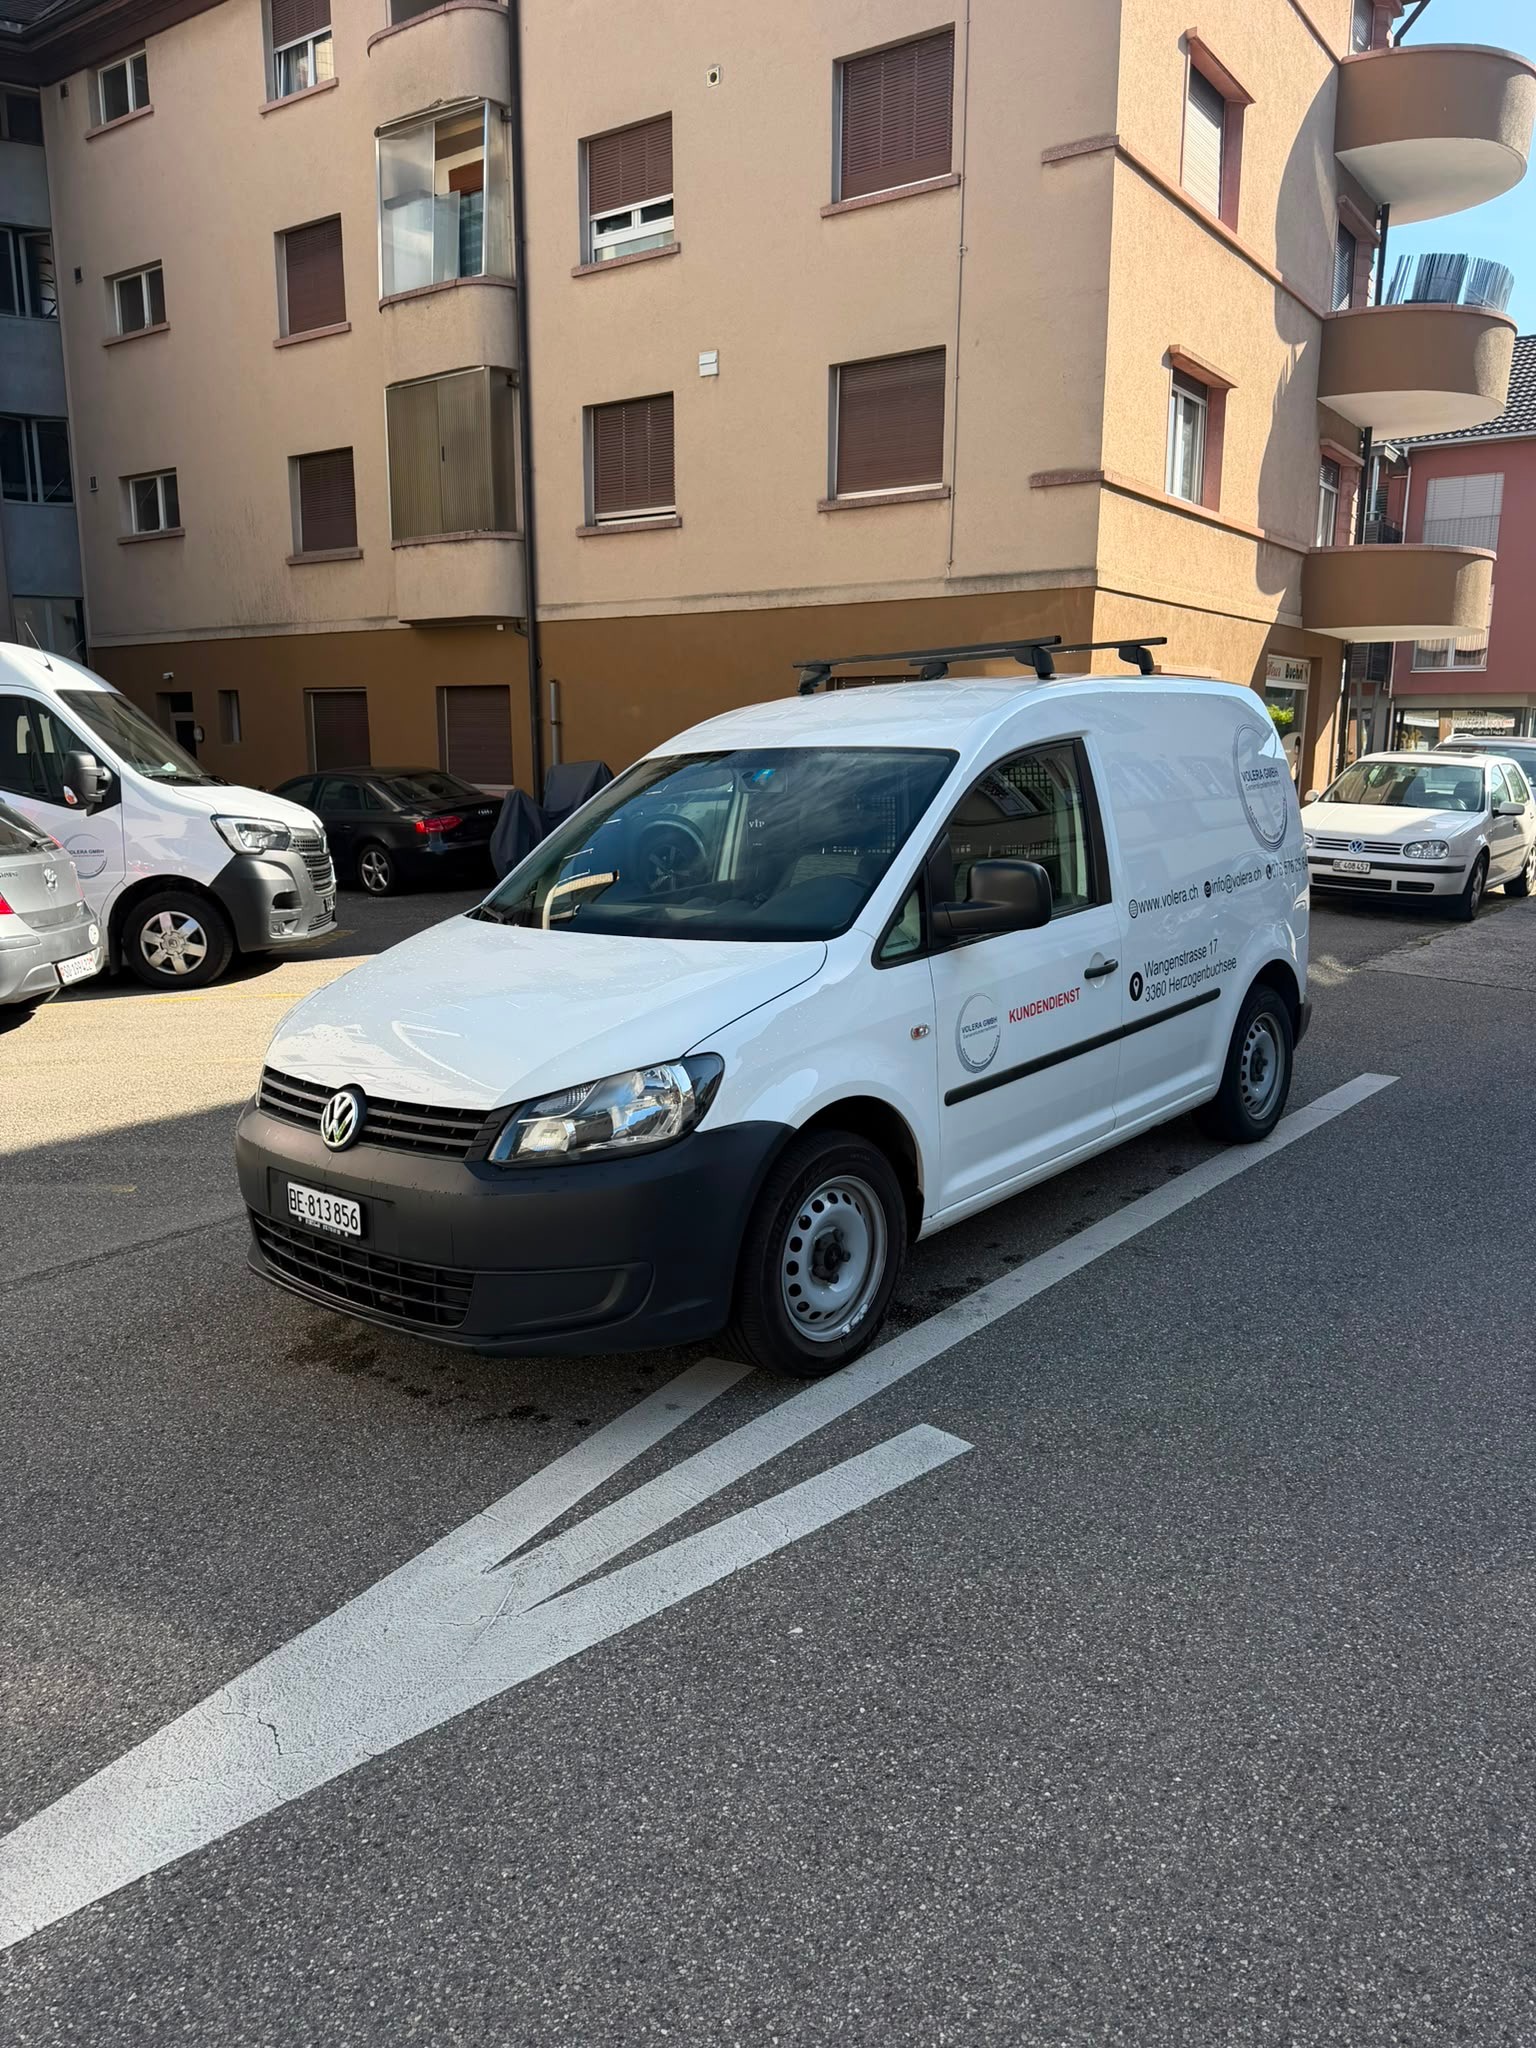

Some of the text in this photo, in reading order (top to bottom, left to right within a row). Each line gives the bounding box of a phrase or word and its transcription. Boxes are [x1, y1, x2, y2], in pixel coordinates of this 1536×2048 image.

[1138, 884, 1199, 913] www.volera.ch
[1211, 868, 1262, 894] info@volera.ch
[1144, 938, 1218, 978] Wangenstrasse 17
[1145, 957, 1237, 1002] 3360 Herzogenbuchsee
[1009, 987, 1081, 1023] KUNDENDIENST
[961, 1021, 982, 1033] VOLERA
